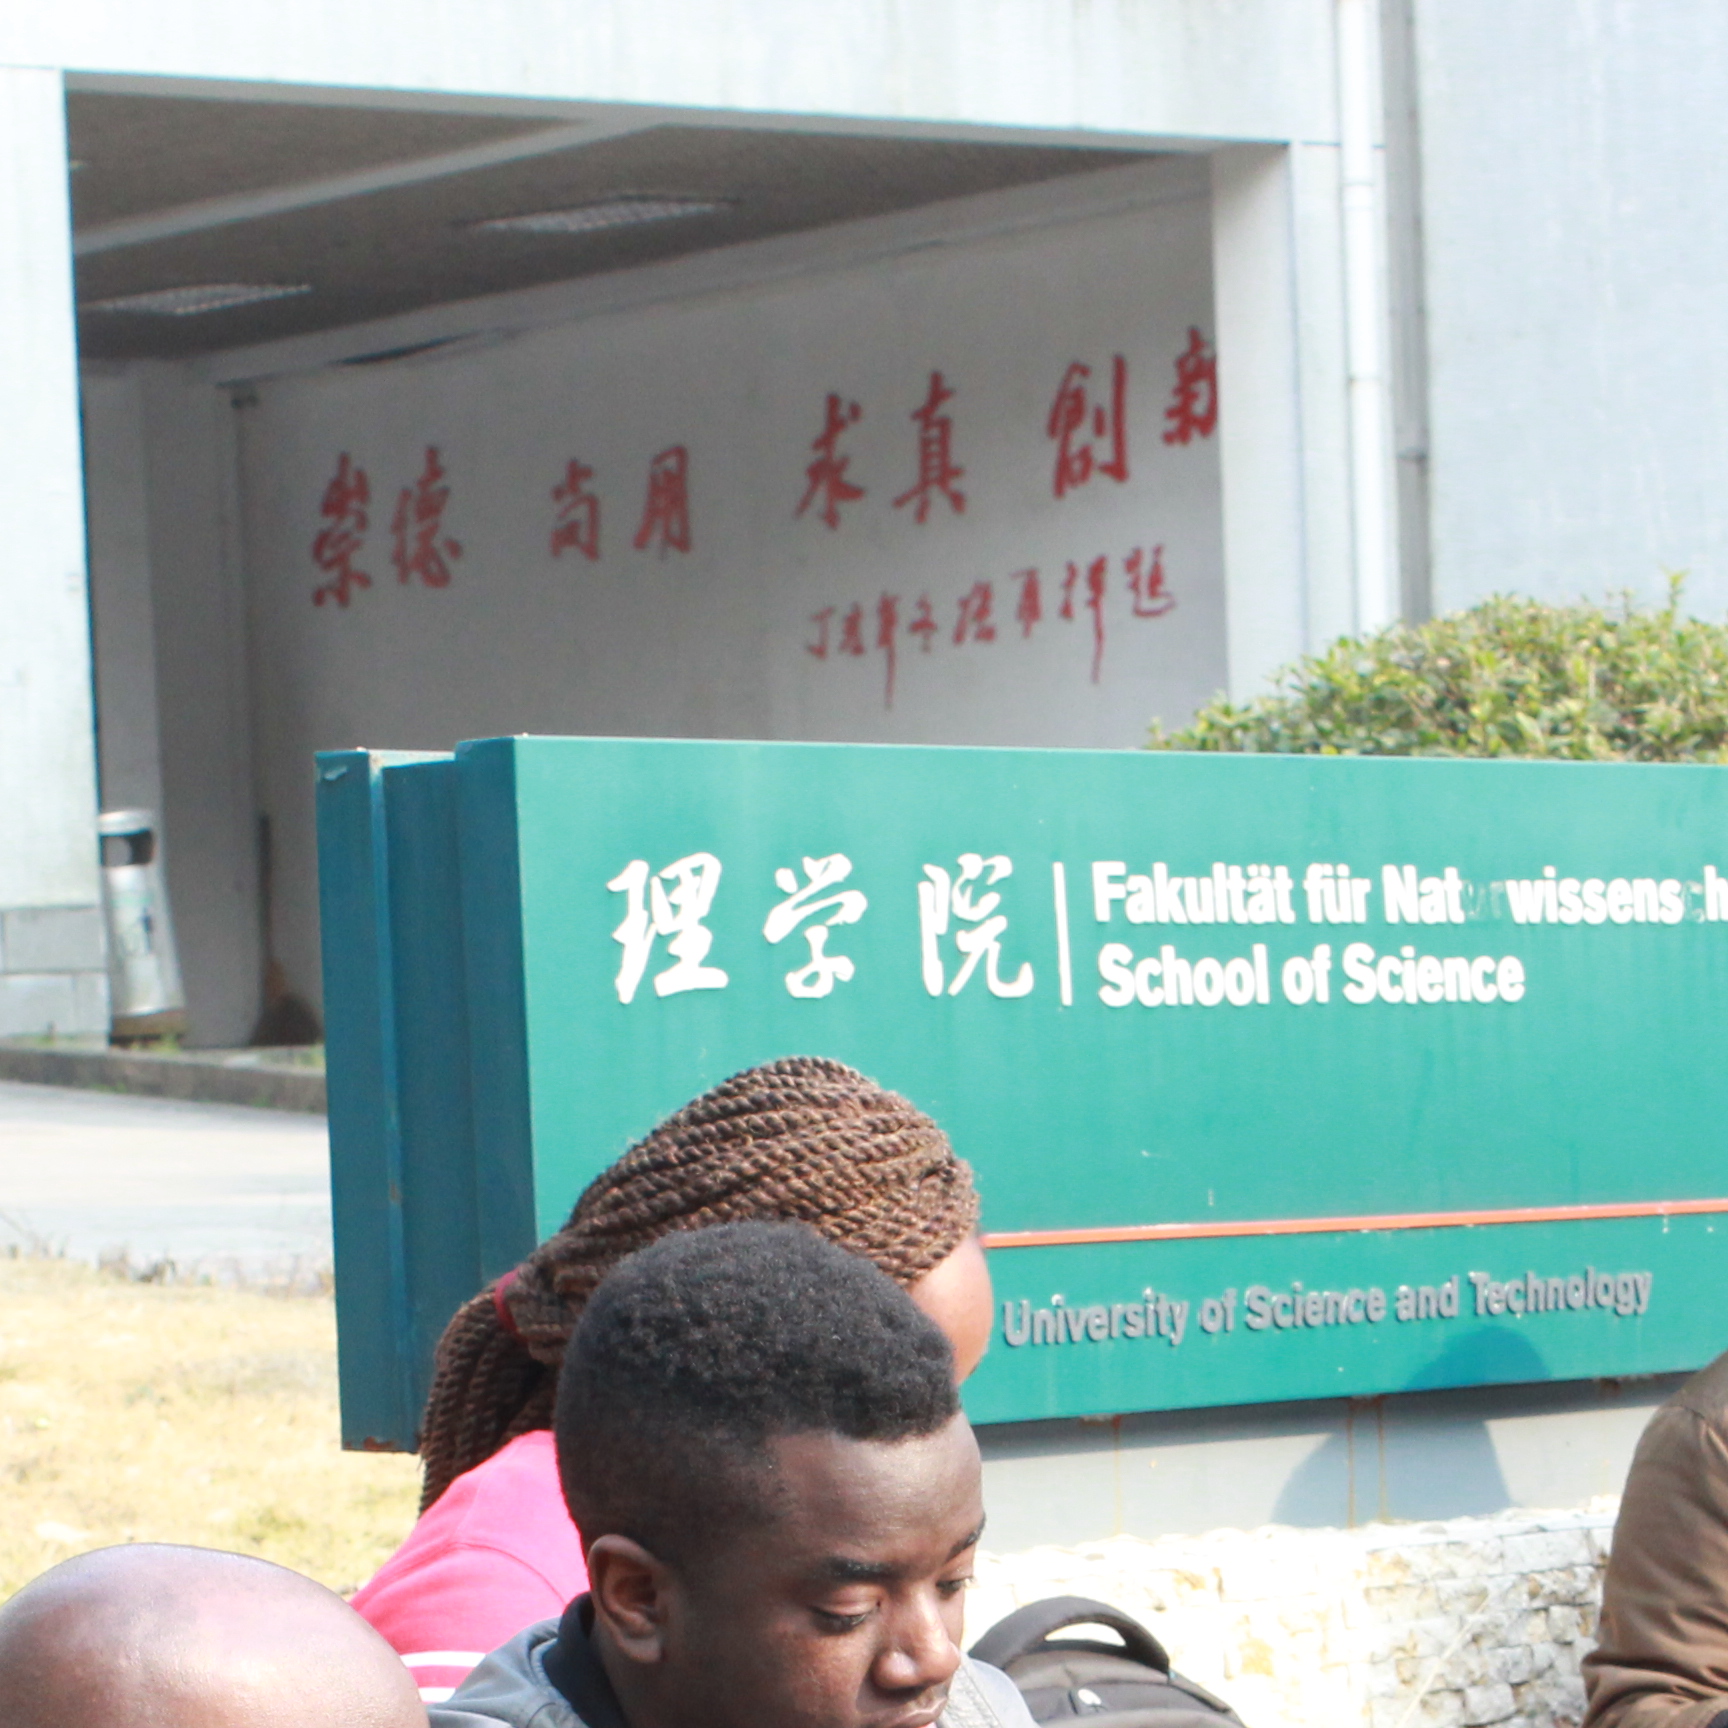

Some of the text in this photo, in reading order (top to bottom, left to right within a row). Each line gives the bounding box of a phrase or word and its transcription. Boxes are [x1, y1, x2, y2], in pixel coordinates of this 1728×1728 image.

[606, 852, 1035, 1005] 理学院
[1091, 861, 1296, 924] Fakultät
[1304, 863, 1372, 924] für
[1098, 942, 1525, 1007] School of Science
[1003, 1266, 1652, 1347] University of Science and Technology
